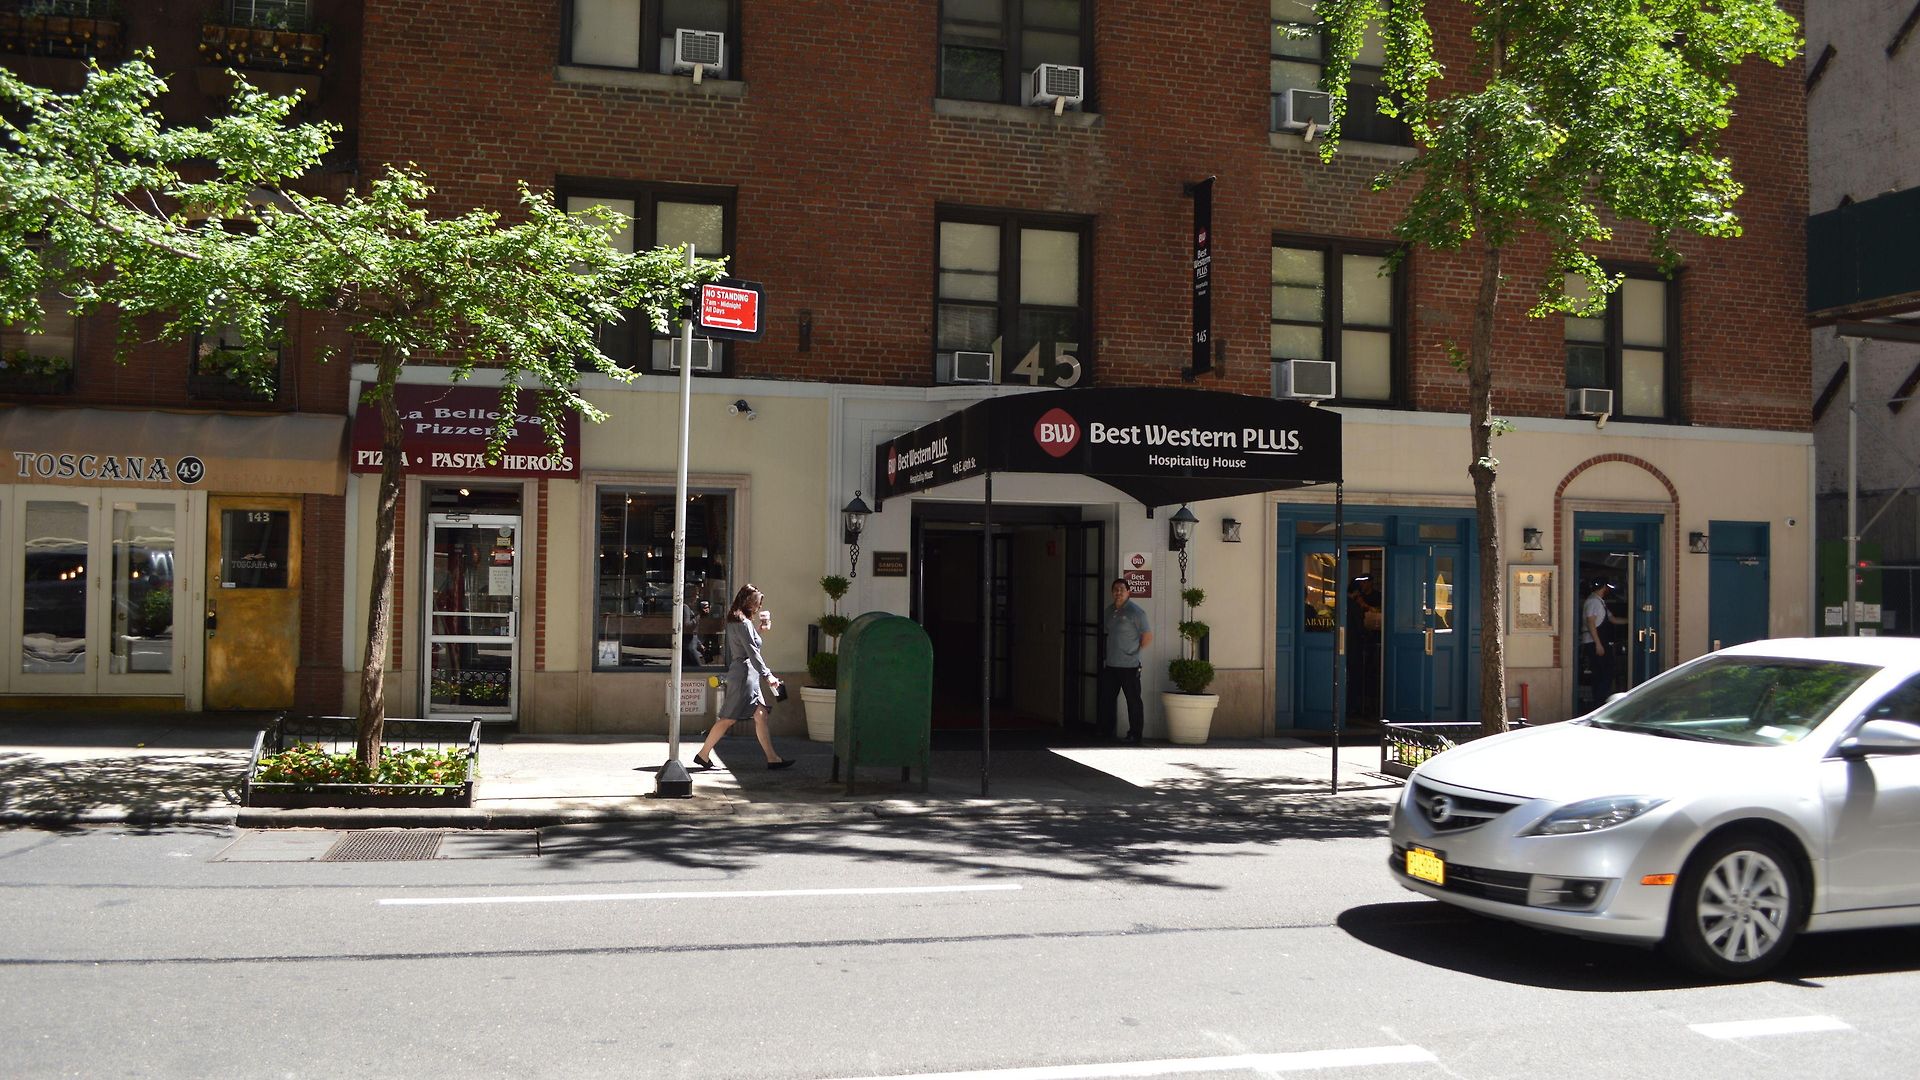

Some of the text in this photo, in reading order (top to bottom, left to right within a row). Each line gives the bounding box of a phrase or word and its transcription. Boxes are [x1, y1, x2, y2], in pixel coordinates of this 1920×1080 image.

[1198, 248, 1207, 259] Best
[1197, 265, 1207, 278] PLUS
[706, 290, 749, 302] NO STANDING
[713, 307, 725, 315] Days
[721, 301, 741, 310] Midnight
[1197, 330, 1207, 343] 145
[992, 336, 1081, 388] 145
[434, 408, 542, 425] Belleza
[416, 424, 519, 437] Pizzera
[1040, 424, 1075, 443] BW
[1090, 422, 1141, 445] Best
[1145, 425, 1237, 448] Western
[358, 451, 574, 471] PIZA PASTA HEROES
[898, 437, 948, 471] Best Western PLUS
[14, 452, 201, 483] TOSCANA 49
[1149, 454, 1246, 469] Hospitality House
[248, 512, 270, 522] 143
[232, 560, 268, 569] TOSCANA
[601, 644, 616, 659] A
